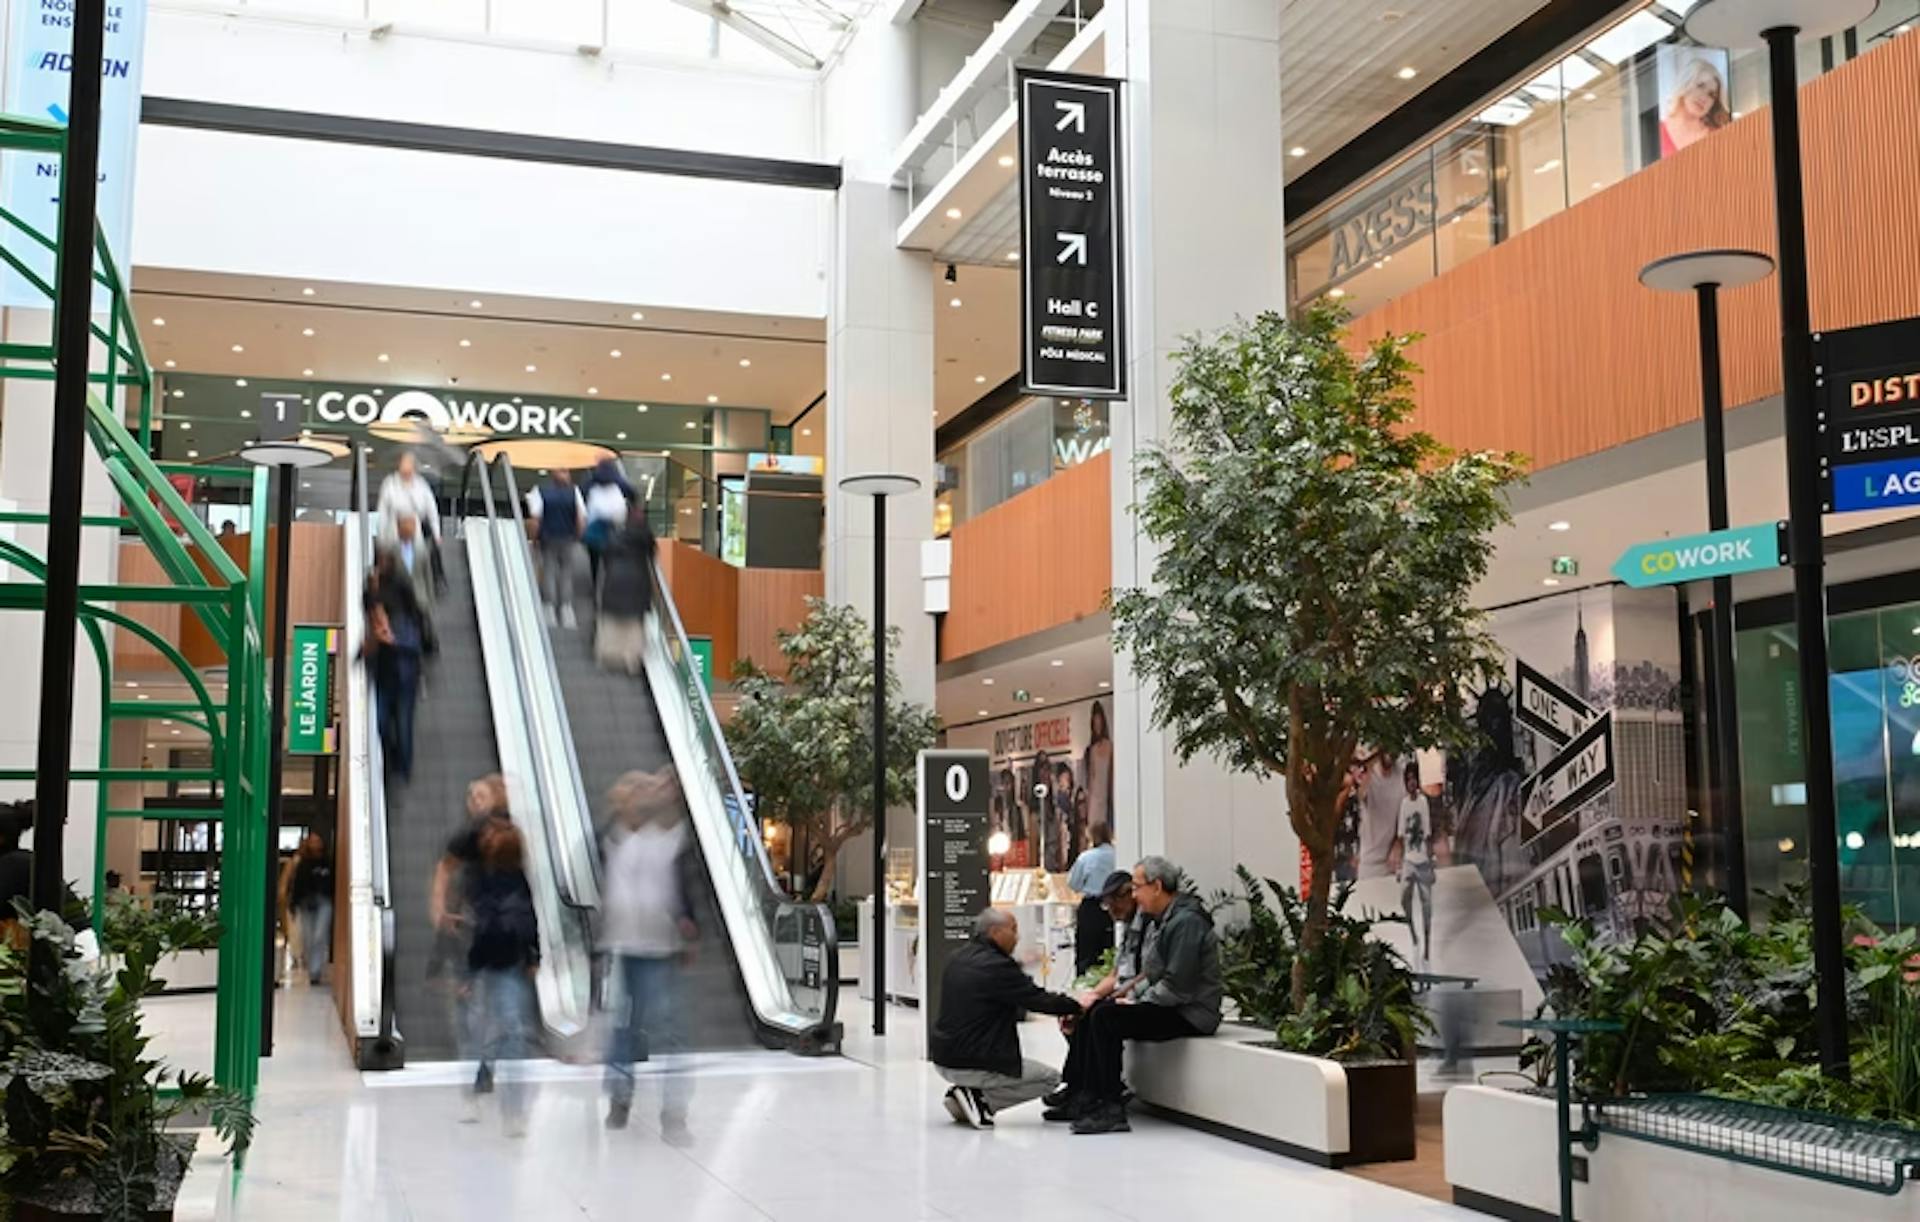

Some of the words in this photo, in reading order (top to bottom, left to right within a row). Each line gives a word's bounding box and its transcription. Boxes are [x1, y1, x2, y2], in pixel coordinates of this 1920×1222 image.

[1037, 163, 1104, 184] terrasse
[1047, 146, 1094, 166] Accès
[1328, 175, 1439, 278] AXESS
[1047, 297, 1082, 317] Hall
[1085, 301, 1099, 318] C
[1850, 373, 1920, 408] DIST
[275, 400, 285, 422] 1
[1641, 538, 1753, 575] COWORK
[294, 642, 319, 712] JARDIN
[300, 714, 317, 735] LE
[1529, 688, 1559, 725] ONE
[946, 764, 970, 802] 0
[1566, 743, 1600, 790] WAY
